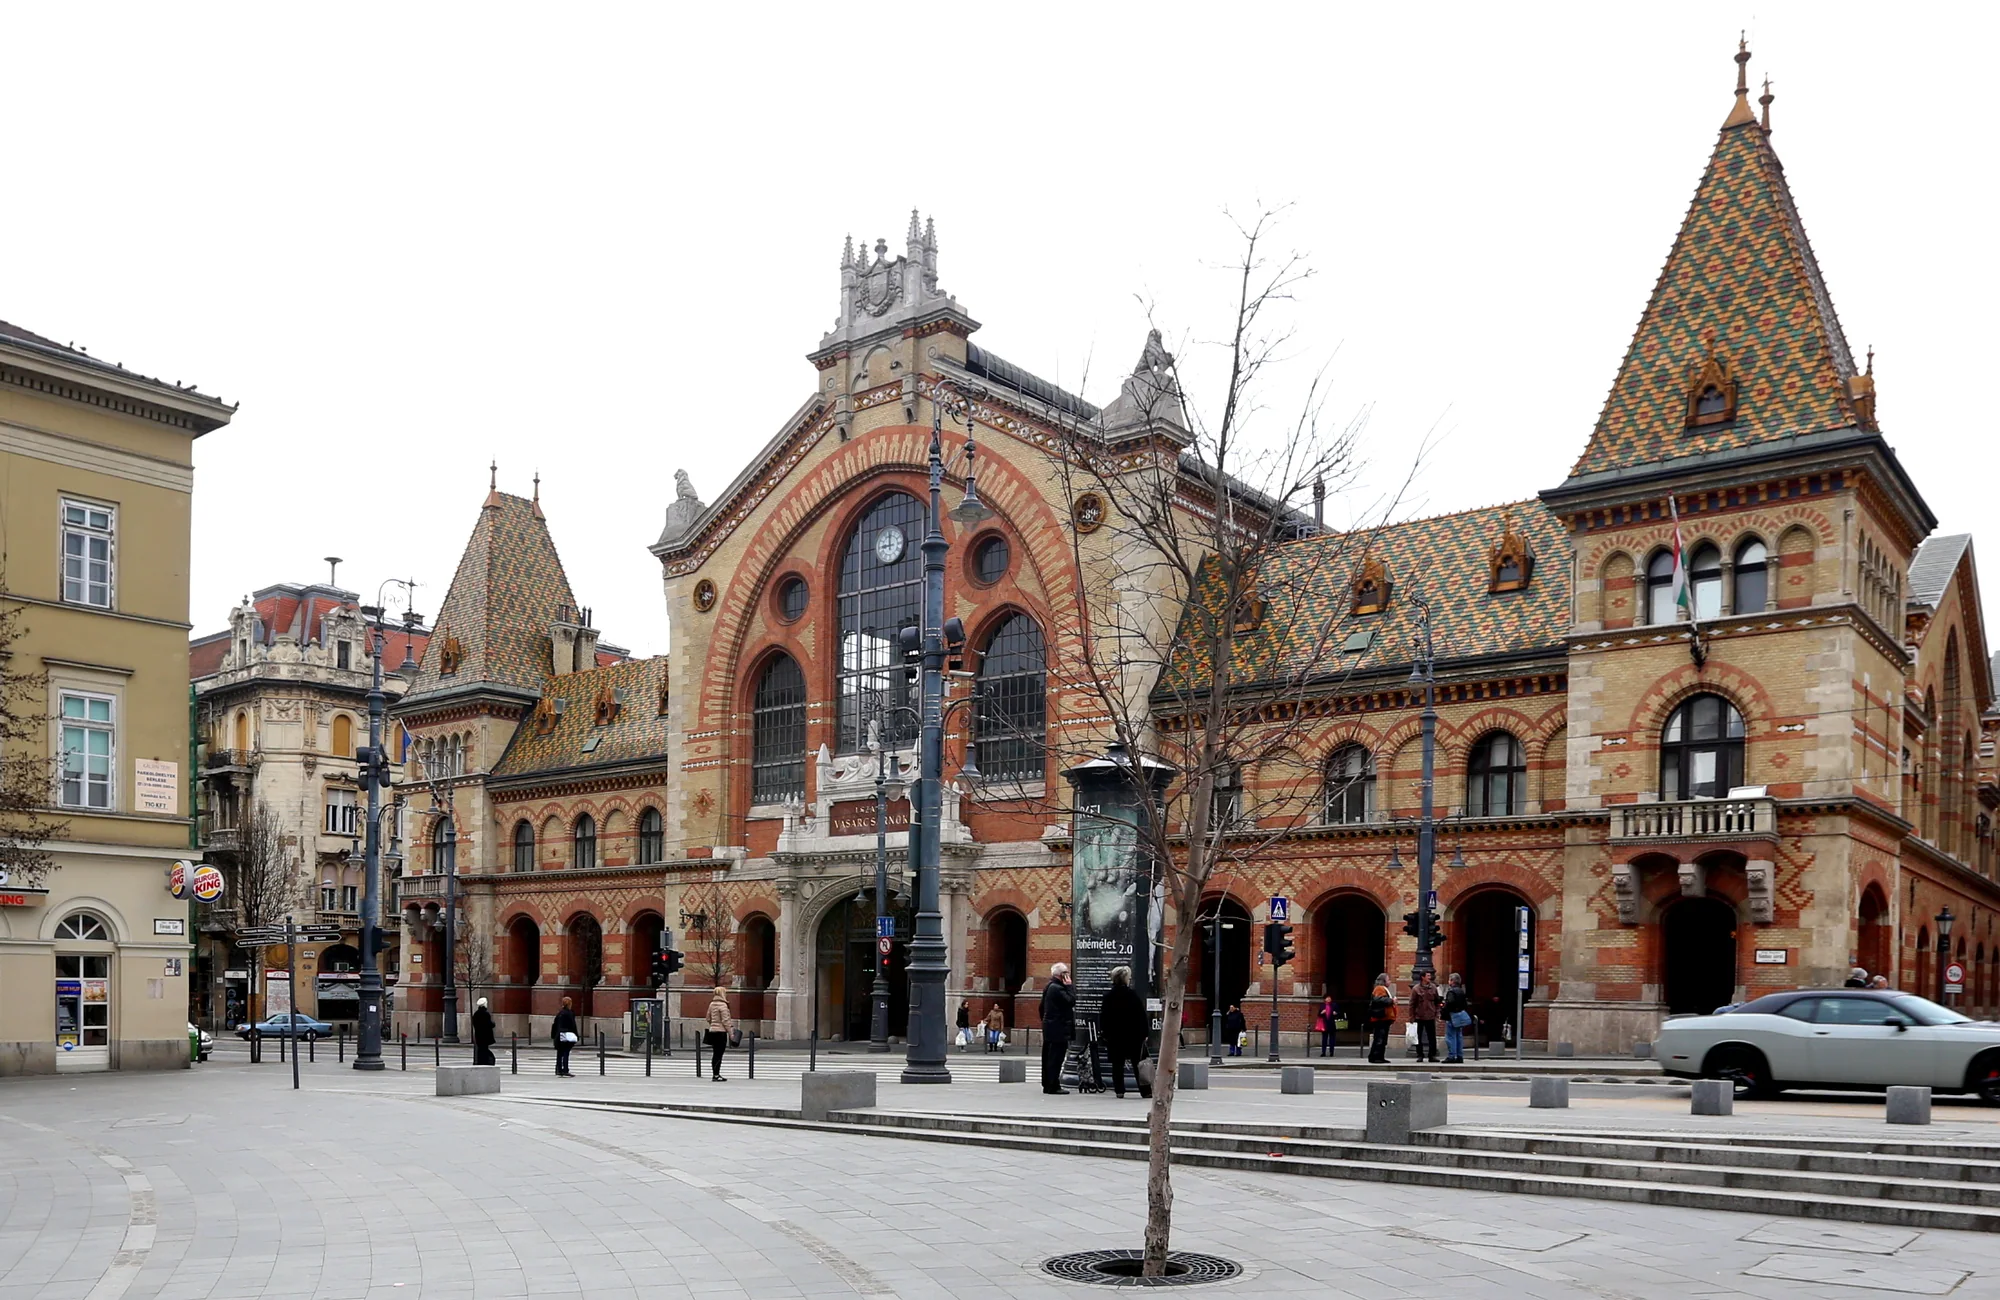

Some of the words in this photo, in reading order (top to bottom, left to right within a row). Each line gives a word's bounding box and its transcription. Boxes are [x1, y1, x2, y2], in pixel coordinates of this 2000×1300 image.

[194, 872, 219, 885] BURGER
[195, 878, 221, 893] KING
[0, 894, 25, 905] ING
[1119, 944, 1133, 955] 2.0
